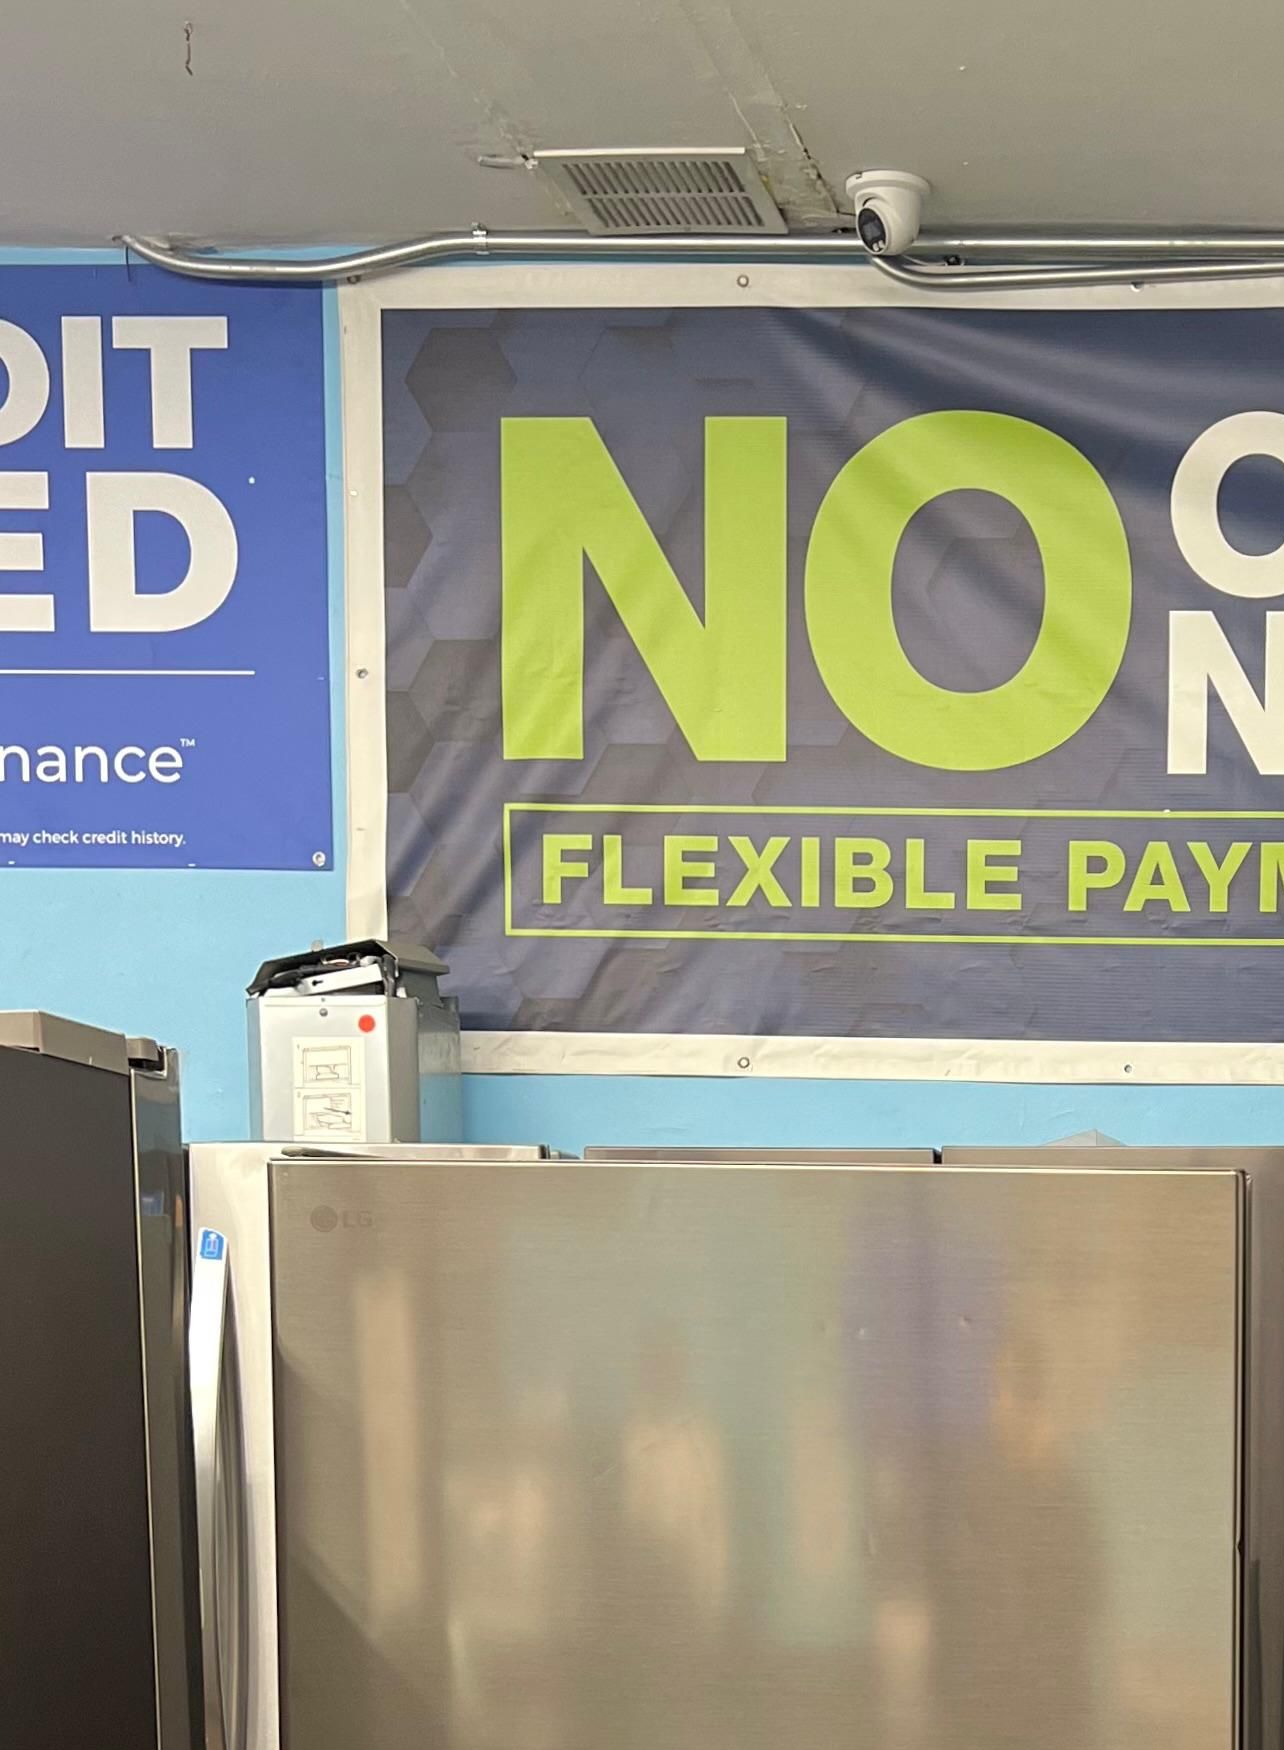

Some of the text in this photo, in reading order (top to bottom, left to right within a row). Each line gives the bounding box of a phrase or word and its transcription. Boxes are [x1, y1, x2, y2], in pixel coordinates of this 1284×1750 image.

[500, 409, 1132, 771] NO
[0, 830, 186, 848] may check credit history.
[542, 833, 1022, 911] FLEXIBLE
